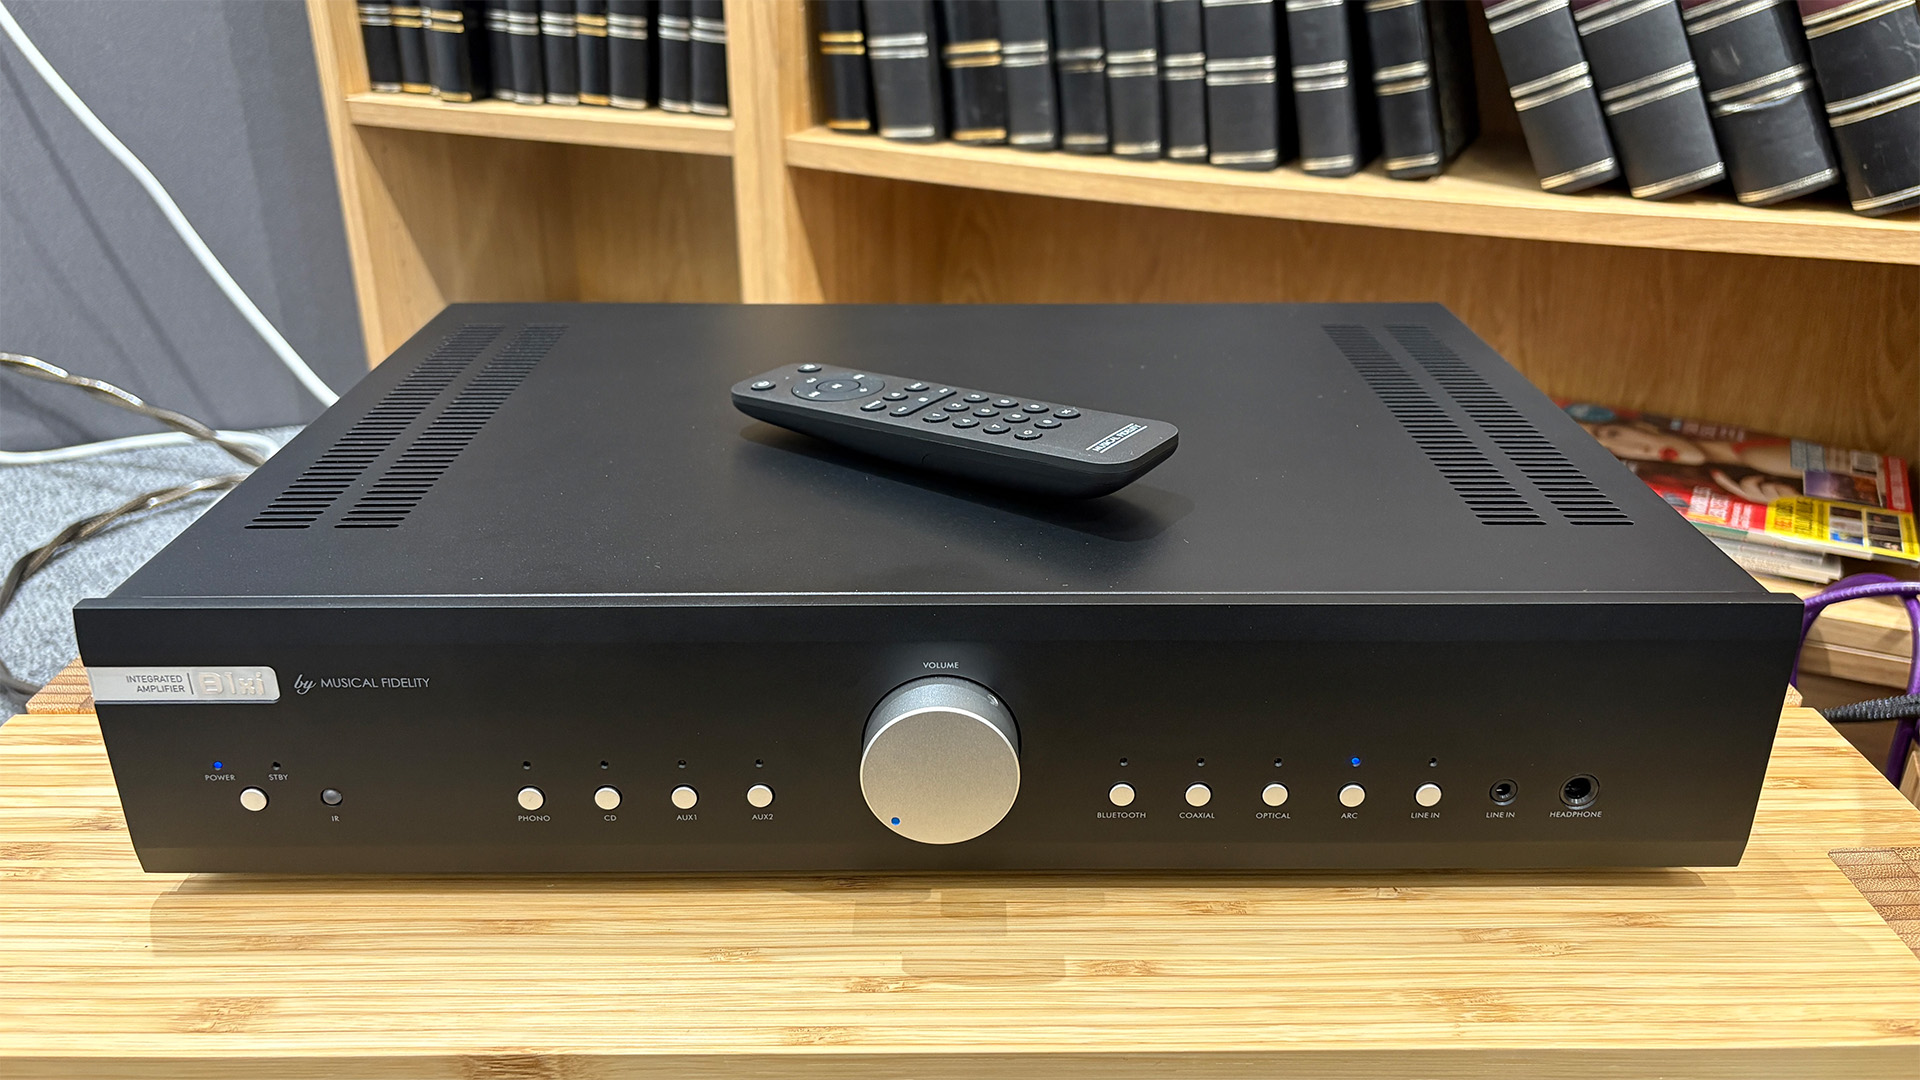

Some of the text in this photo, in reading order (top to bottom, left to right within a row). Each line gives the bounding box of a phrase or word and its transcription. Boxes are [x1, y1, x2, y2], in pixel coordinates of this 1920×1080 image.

[923, 661, 959, 669] VOLUME
[126, 675, 183, 684] INTEGRATED
[293, 674, 430, 695] by MUSICAL FIDELITY
[136, 684, 186, 694] AMPLIFIER
[603, 814, 617, 822] CD
[751, 813, 774, 821] AUX2
[1096, 811, 1147, 819] BLUETOOTH
[1179, 811, 1216, 819] COAXIAL
[1255, 811, 1291, 819] OPTICAL
[1341, 811, 1359, 819] ARC
